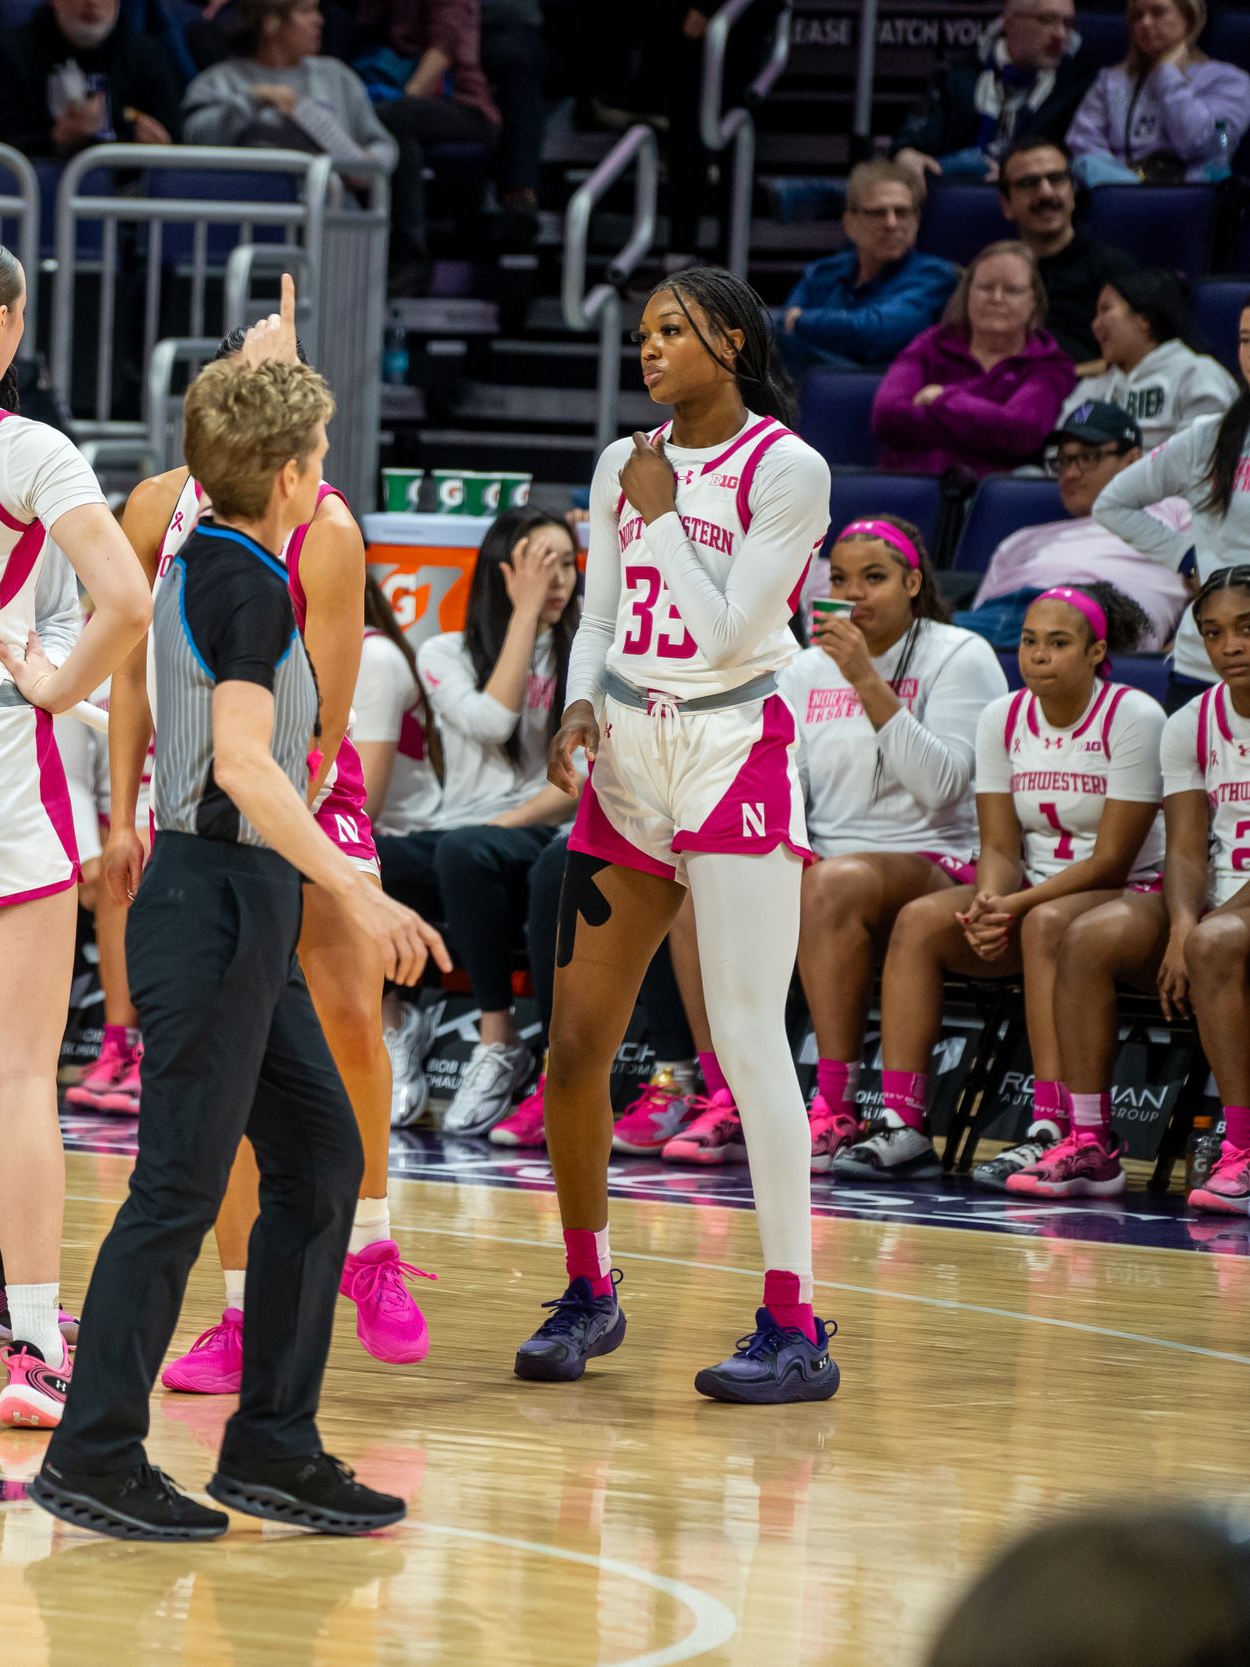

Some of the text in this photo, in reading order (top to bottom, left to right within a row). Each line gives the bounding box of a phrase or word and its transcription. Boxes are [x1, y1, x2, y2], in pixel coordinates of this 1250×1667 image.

[878, 19, 939, 45] ATCH
[382, 572, 417, 625] G
[334, 813, 361, 843] N
[741, 803, 767, 837] N
[1039, 802, 1075, 860] 1
